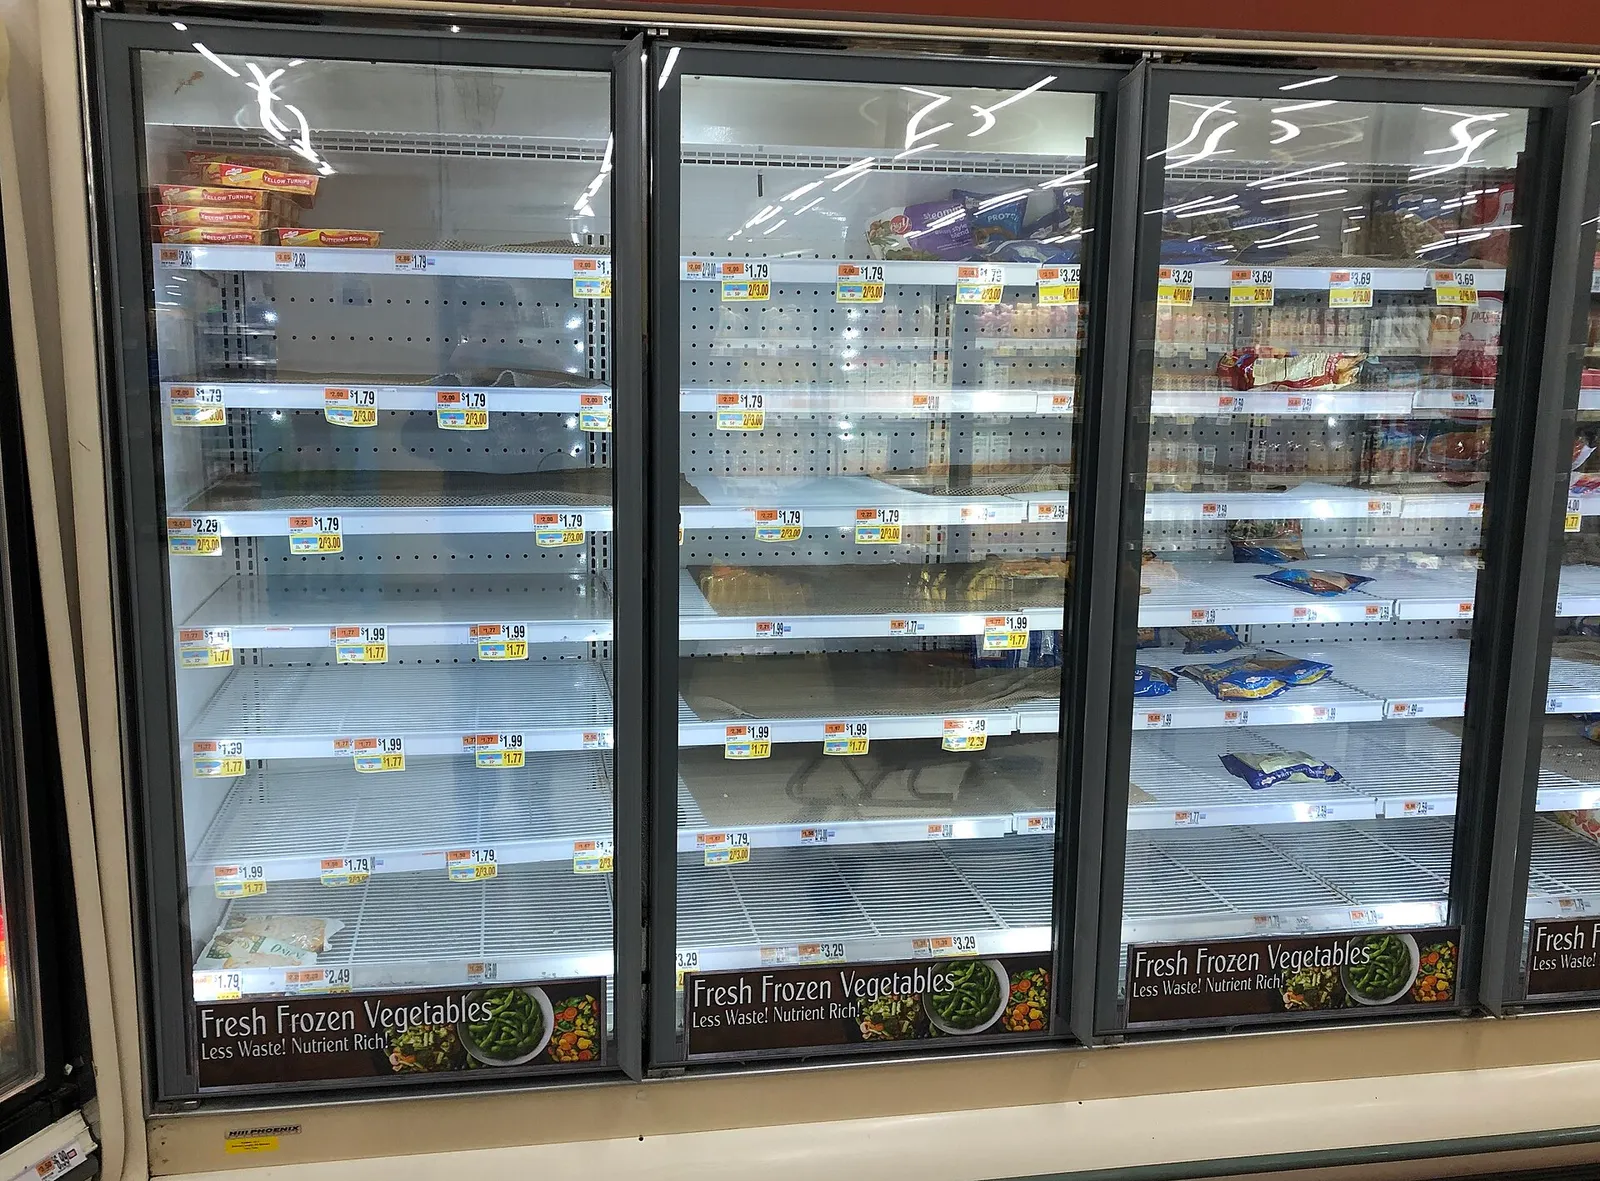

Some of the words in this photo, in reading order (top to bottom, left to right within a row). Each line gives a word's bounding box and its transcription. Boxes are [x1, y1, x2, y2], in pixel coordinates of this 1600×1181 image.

[264, 175, 285, 184] YELLOW
[204, 194, 226, 202] YELLOW
[179, 251, 192, 266] $2.89
[293, 253, 306, 267] $2.89
[412, 255, 426, 271] $1.79
[745, 264, 768, 278] $1.79
[861, 267, 882, 280] $1.79
[1060, 269, 1080, 282] $3.29
[1172, 271, 1192, 284] $3.29
[1252, 271, 1272, 283] $3.69
[1351, 272, 1370, 285] $3.69
[1455, 273, 1474, 285] $3.69
[749, 285, 768, 296] 2/$3.00
[863, 286, 883, 298] 2/$3.00
[350, 390, 375, 405] $1.79
[461, 393, 486, 407] $1.79
[740, 395, 763, 408] $1.79
[354, 410, 375, 422] 2/$3.00
[465, 413, 487, 425] 2/$3.00
[559, 514, 582, 527] $1.79
[779, 511, 800, 524] $1.79
[878, 510, 899, 522] $1.79
[193, 519, 218, 533] $2.29
[315, 517, 339, 531] $1.79
[881, 528, 899, 539] 2/$3.00
[319, 537, 340, 549] 2/$3.00
[771, 622, 784, 636] $1.99
[905, 621, 917, 633] $1.77
[1007, 617, 1027, 629] $1.99
[361, 628, 385, 641] $1.99
[502, 625, 525, 638] $1.99
[1010, 635, 1026, 646] $1.77
[211, 649, 230, 662] $1.77
[366, 646, 385, 659] $1.77
[506, 644, 524, 656] $1.77
[748, 726, 768, 738] $1.99
[846, 724, 867, 736] $1.99
[378, 738, 401, 751] $1.99
[500, 735, 522, 748] $1.99
[850, 741, 866, 751] $1.77
[752, 743, 768, 754] $1.77
[383, 757, 402, 767] $1.77
[504, 753, 522, 763] $1.77
[222, 761, 242, 772] $1.77
[727, 833, 748, 845] $1.79
[472, 850, 494, 862] $1.79
[345, 859, 367, 871] $1.79
[239, 866, 263, 878] $1.99
[244, 883, 263, 893] $1.77
[953, 937, 976, 950] $3.29
[1536, 925, 1584, 951] Fresh
[821, 944, 843, 957] $3.29
[1135, 950, 1188, 978] Fresh
[1197, 948, 1260, 974] Frozen
[1268, 941, 1370, 974] Vegetables
[1533, 956, 1556, 971] Less
[1561, 952, 1596, 968] Waste!
[214, 975, 239, 989] $1.79
[325, 969, 350, 983] $2.49
[694, 978, 751, 1007] Fresh
[762, 975, 831, 1002] Frozen
[840, 967, 954, 1002] Vegetables
[1133, 983, 1158, 998] Less
[1163, 978, 1201, 995] Waste!
[1206, 977, 1252, 992] Nutrient
[1256, 973, 1284, 989] Rich!
[202, 1007, 266, 1038] Fresh
[277, 1005, 354, 1034] Frozen
[364, 995, 492, 1033] Vegetables
[693, 1012, 720, 1028] Less
[726, 1008, 768, 1025] Waste!
[774, 1006, 825, 1022] Nutrient
[830, 1002, 860, 1018] Rich!
[202, 1043, 233, 1059] Less
[238, 1038, 286, 1057] Waste!
[292, 1037, 348, 1054] Nutrient
[354, 1033, 389, 1049] Rich!
